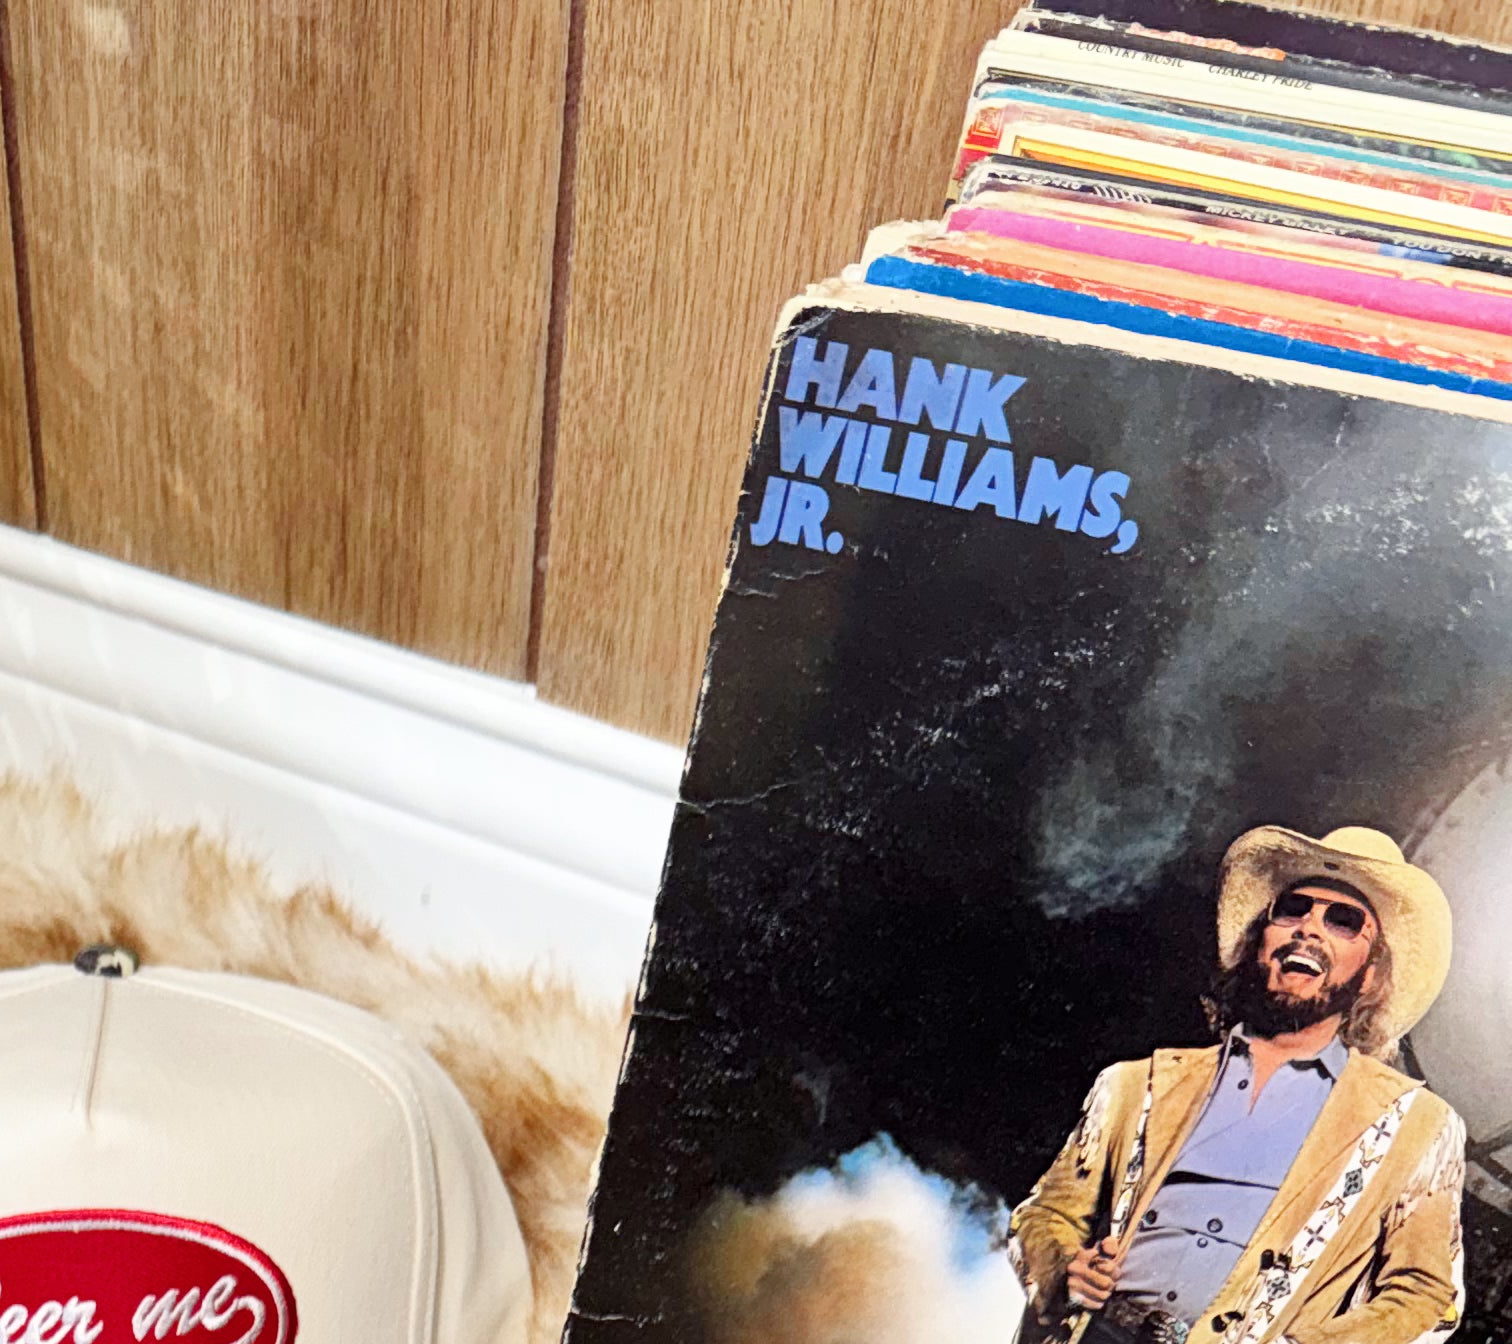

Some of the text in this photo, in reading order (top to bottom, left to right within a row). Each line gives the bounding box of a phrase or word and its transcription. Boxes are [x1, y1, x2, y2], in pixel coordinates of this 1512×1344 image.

[784, 336, 1027, 445] HANK
[750, 476, 845, 555] JR.
[778, 406, 1140, 554] WILLIAMS,
[131, 1274, 250, 1342] me
